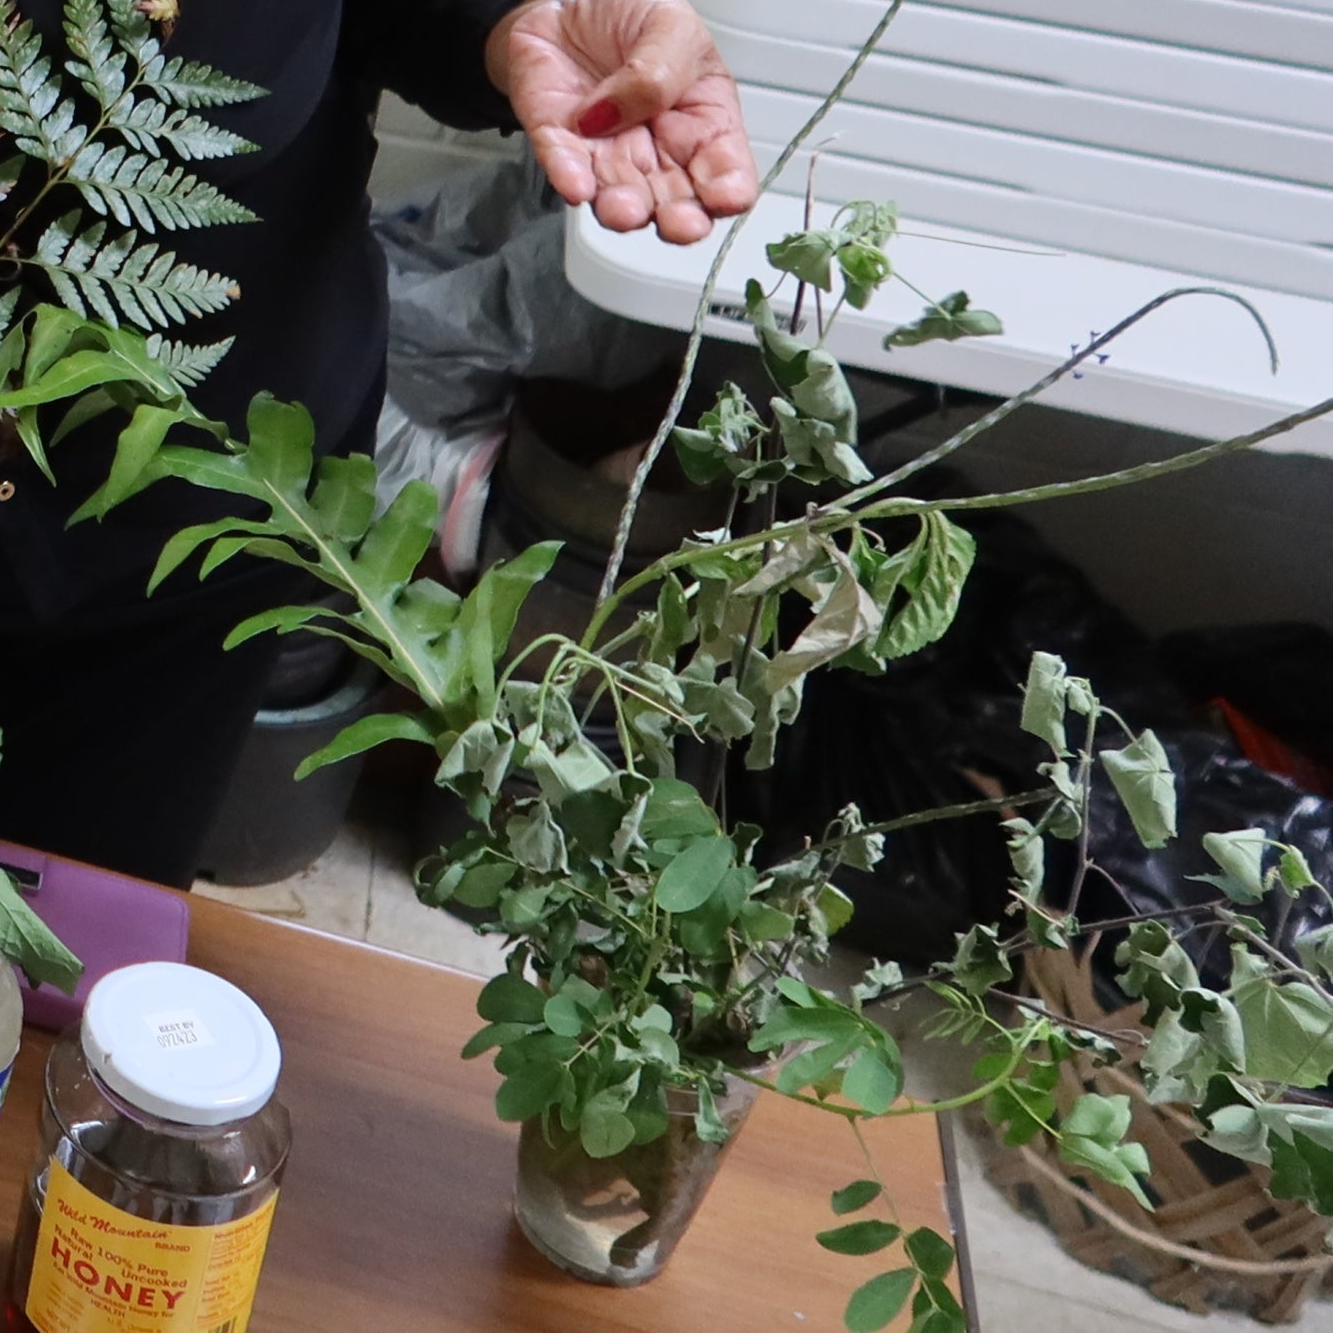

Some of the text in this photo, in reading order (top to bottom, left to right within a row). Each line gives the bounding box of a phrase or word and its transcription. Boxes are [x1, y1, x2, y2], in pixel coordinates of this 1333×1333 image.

[57, 1198, 87, 1225] Wild
[155, 1242, 191, 1253] BRAND
[51, 1237, 185, 1309] HONEY
[121, 1268, 188, 1288] Uncooked
[137, 1263, 168, 1277] Pure
